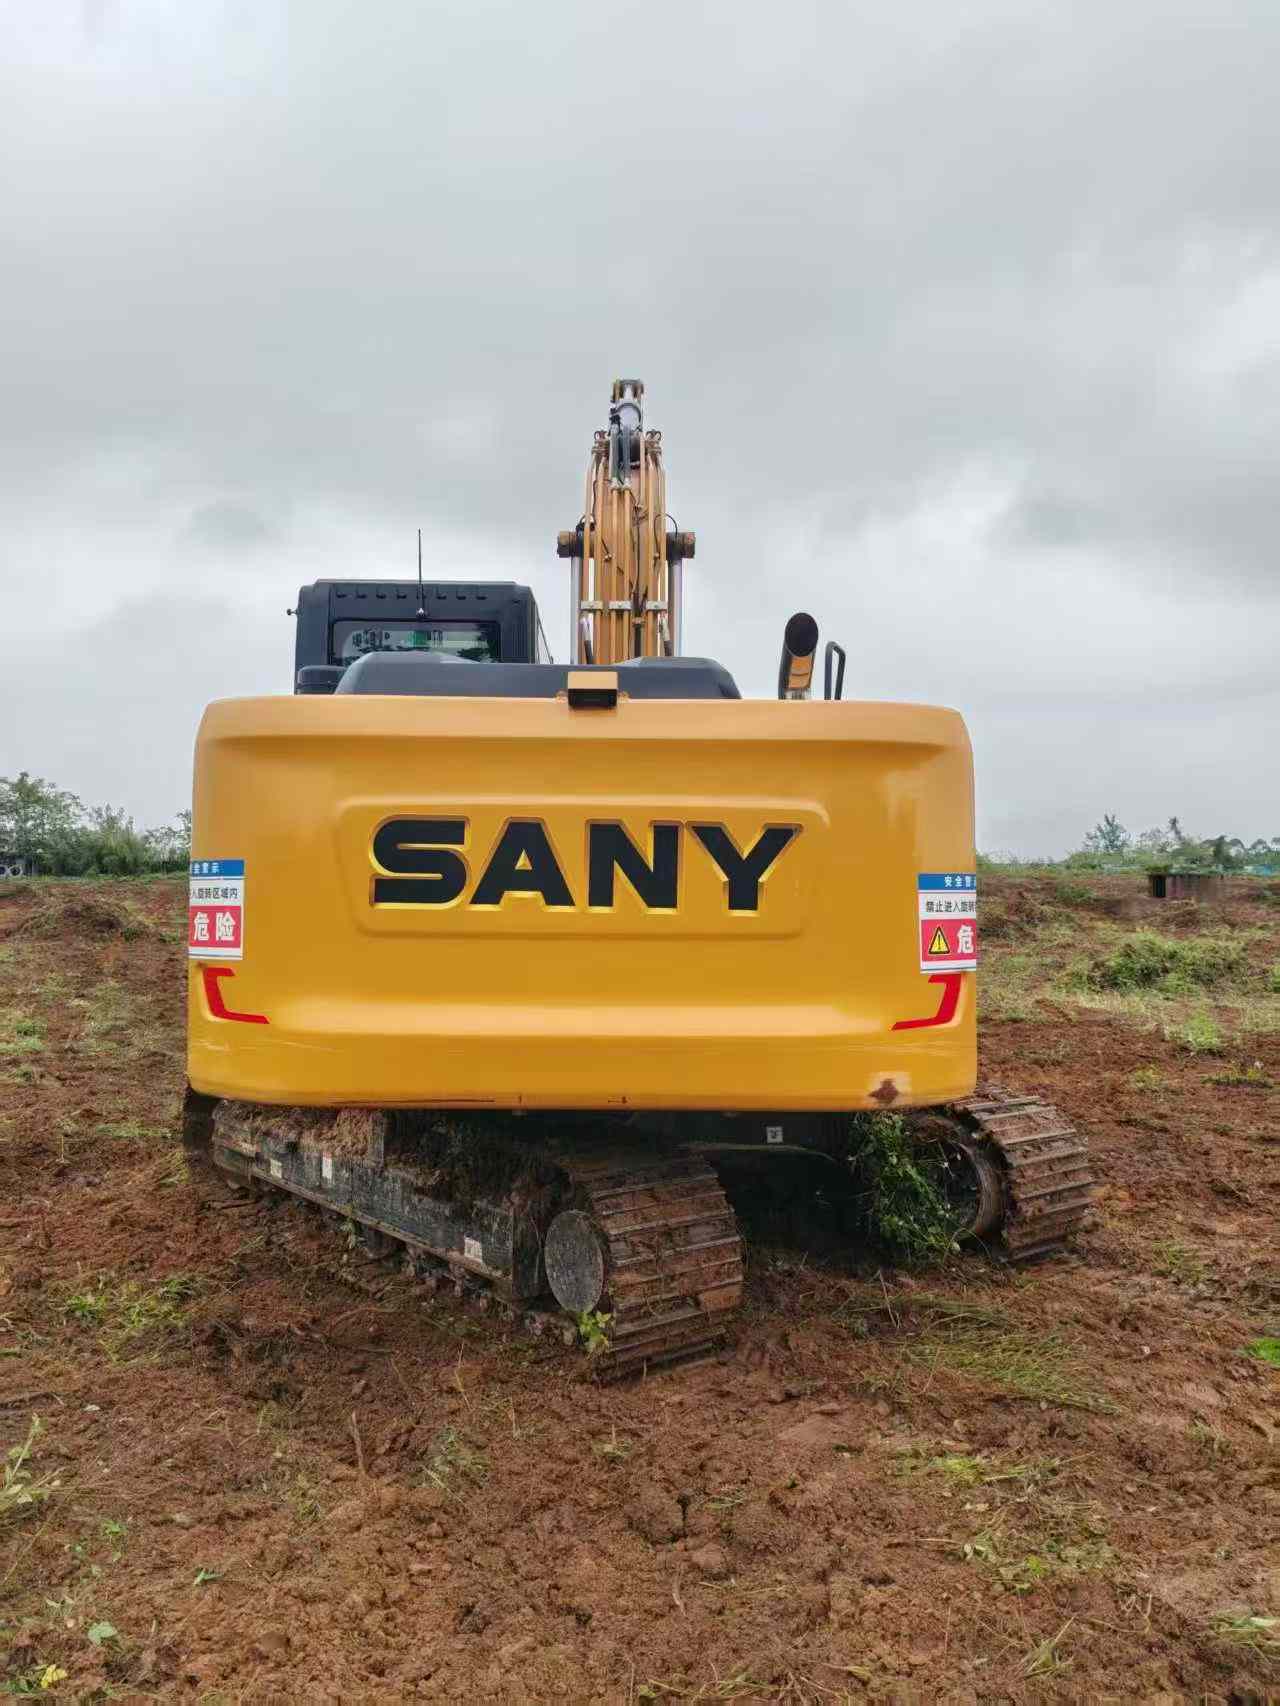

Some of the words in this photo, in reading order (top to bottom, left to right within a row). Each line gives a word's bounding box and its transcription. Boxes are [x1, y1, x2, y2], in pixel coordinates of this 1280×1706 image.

[372, 815, 800, 913] SANY
[194, 911, 236, 941] 危险
[957, 924, 974, 954] 危
